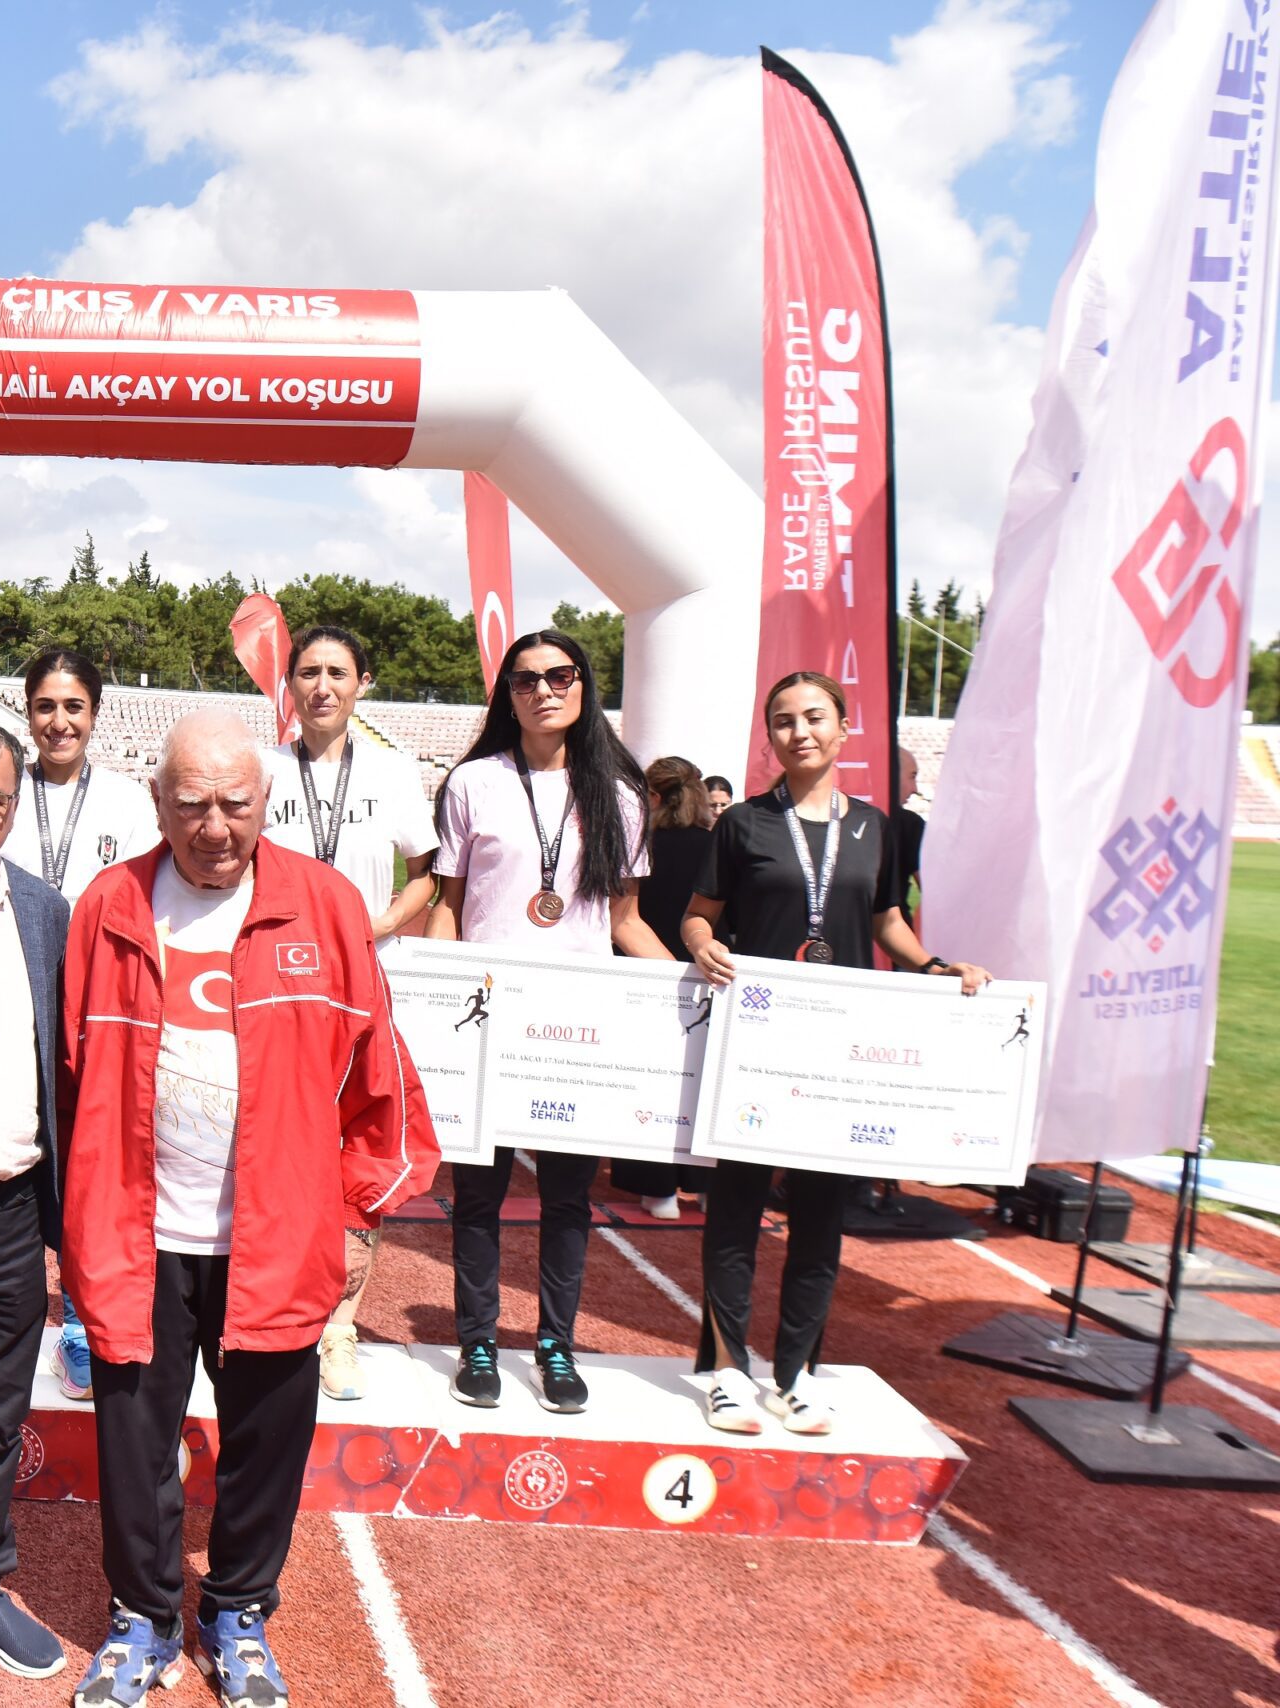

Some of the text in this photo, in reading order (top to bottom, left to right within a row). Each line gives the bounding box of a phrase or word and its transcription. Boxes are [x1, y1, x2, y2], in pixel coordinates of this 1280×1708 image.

[1, 286, 341, 322] ÇIKIŞ / VARIŞ
[64, 374, 178, 408] AKÇAY
[184, 376, 250, 402] YOL
[259, 378, 394, 411] KOŞUSU
[550, 841, 559, 864] ÜRKİYE
[526, 1023, 600, 1044] 6.000 TL
[849, 1044, 923, 1066] 5.000 TL
[439, 1067, 465, 1076] Sporcu
[531, 1099, 576, 1113] HAKAN
[431, 1115, 462, 1124] LTIEYLÜL
[851, 1123, 897, 1135] HAKAN
[663, 1469, 693, 1509] 4
